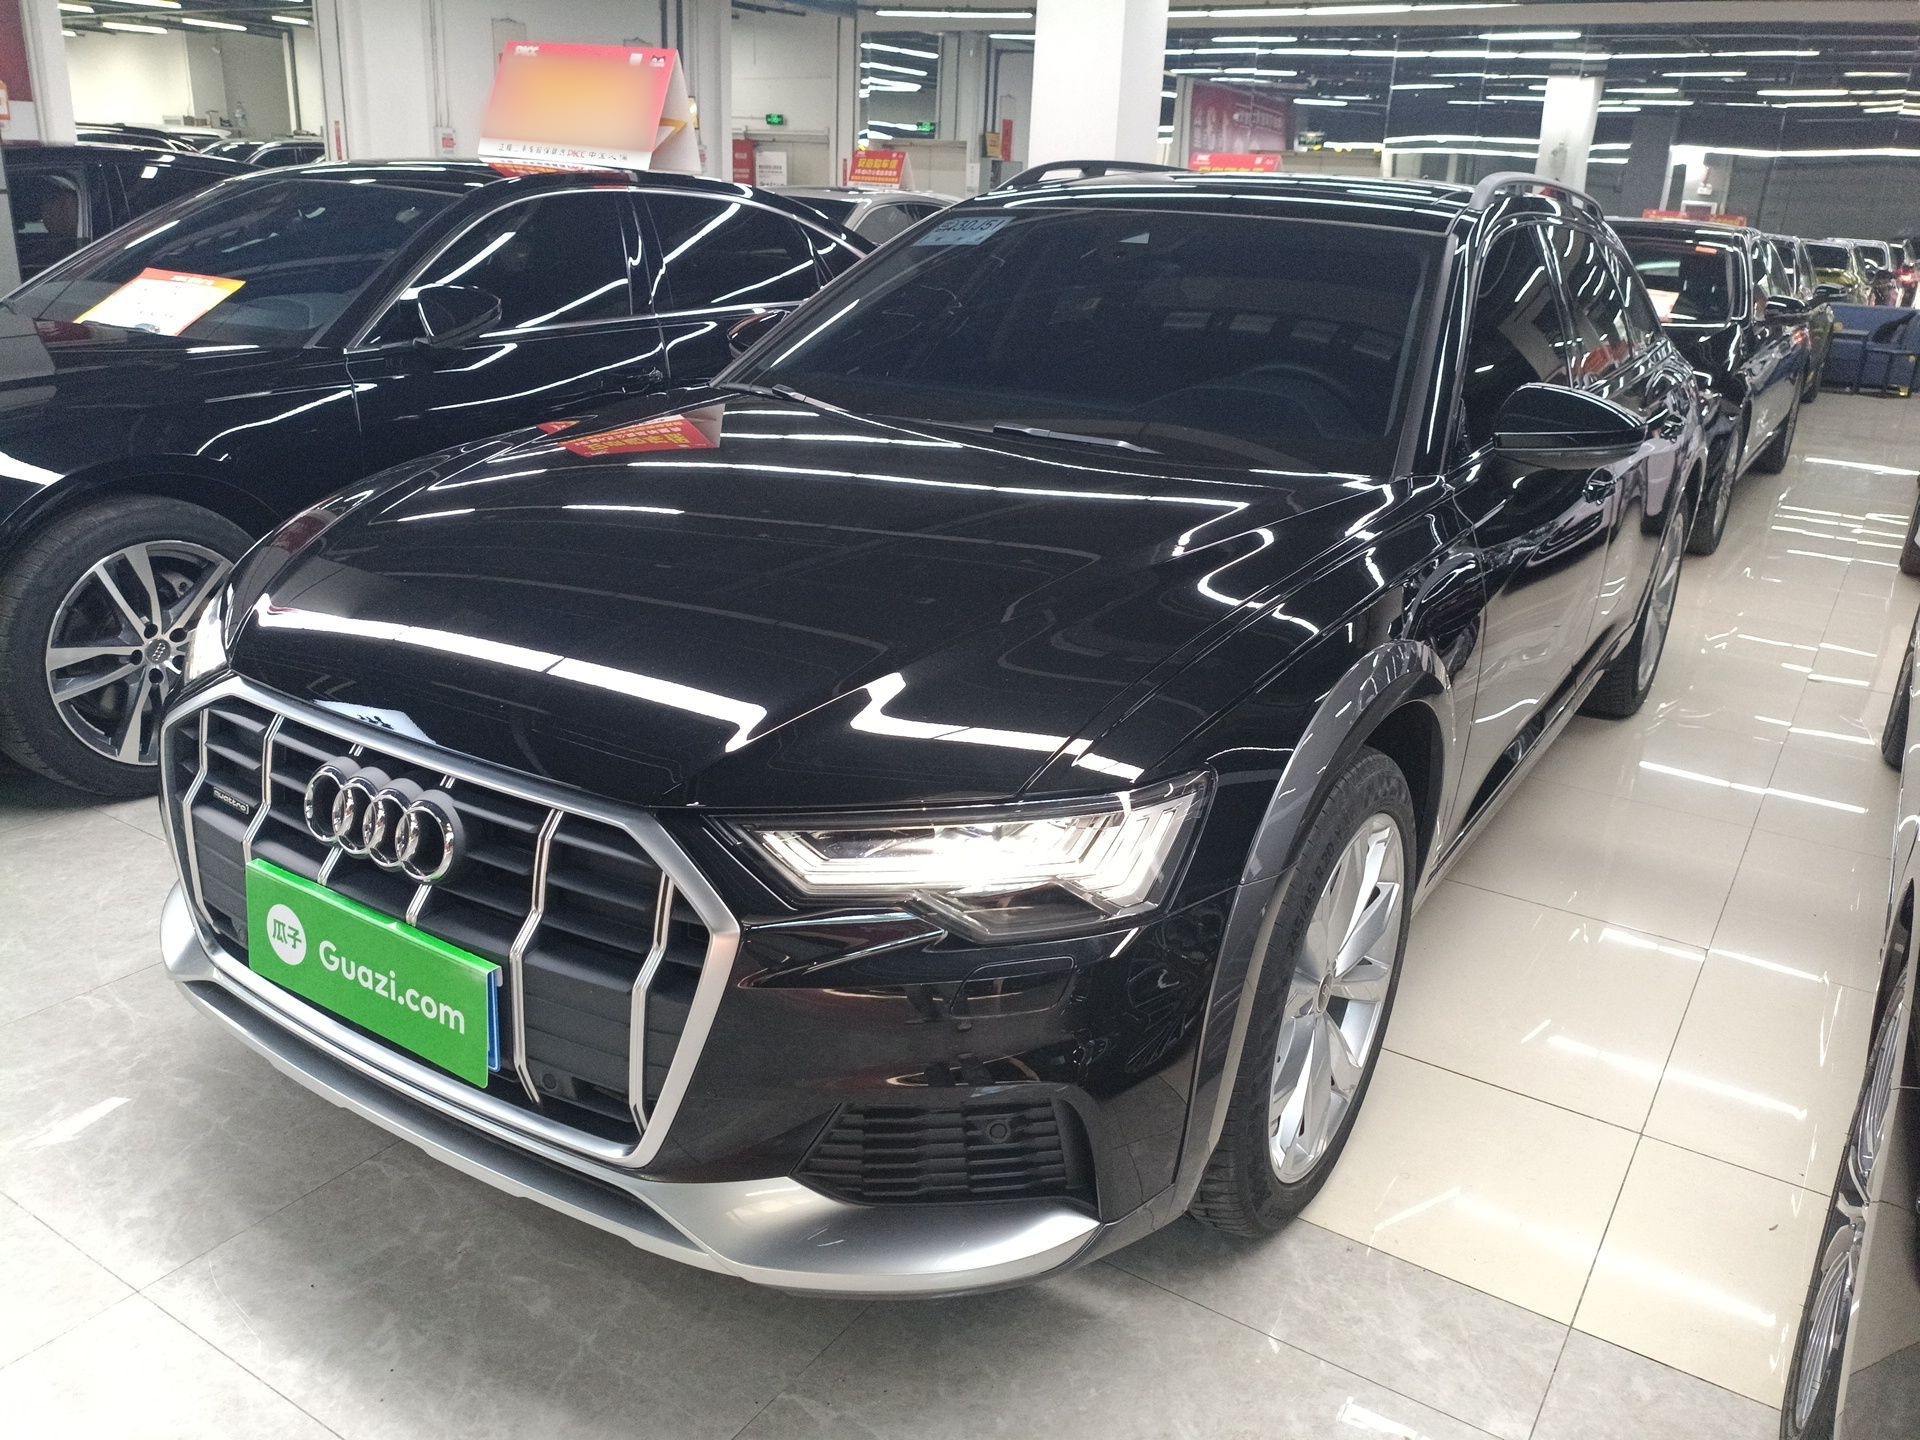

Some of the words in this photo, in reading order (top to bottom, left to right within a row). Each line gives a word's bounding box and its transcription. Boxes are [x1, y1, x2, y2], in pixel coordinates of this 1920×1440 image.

[214, 790, 247, 812] quattro
[272, 918, 302, 950] 瓜子
[318, 940, 465, 1036] Guazi.com
